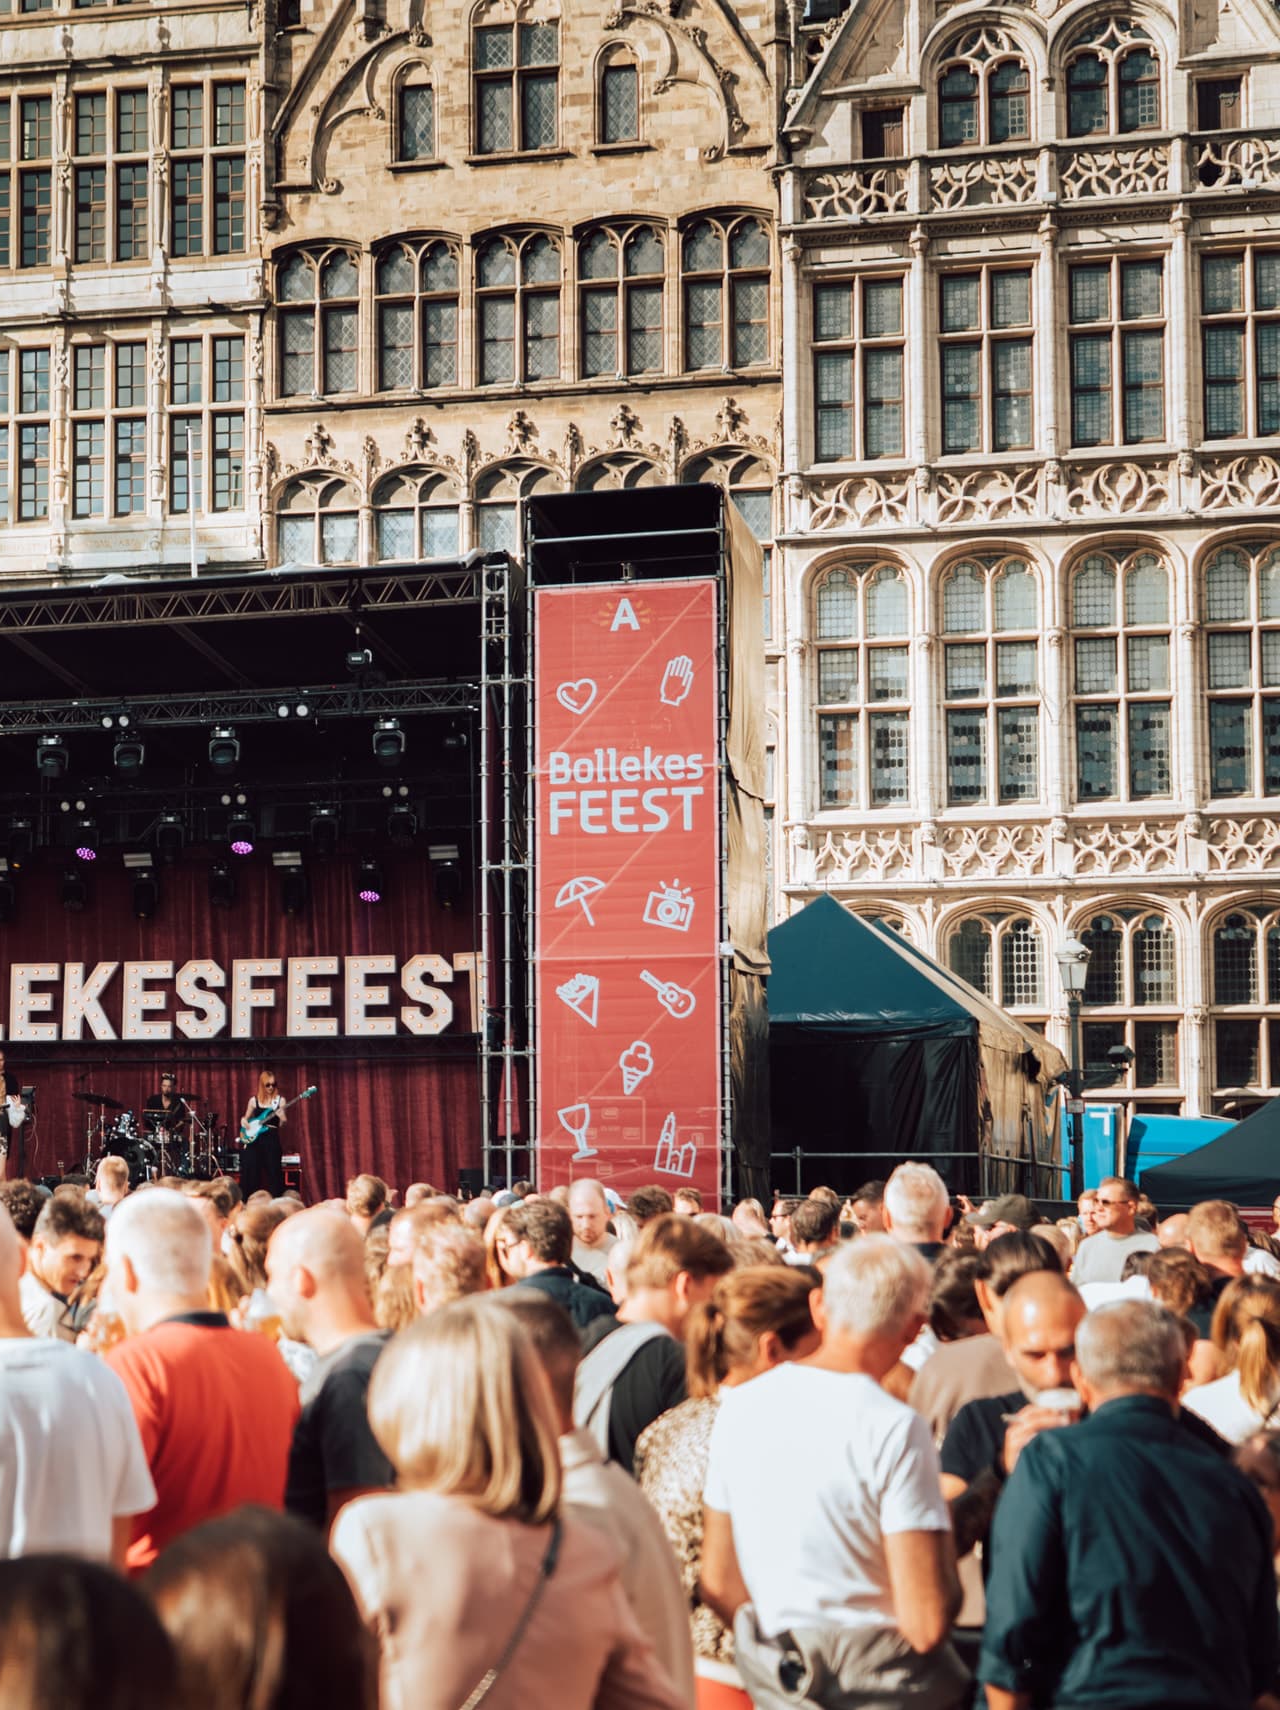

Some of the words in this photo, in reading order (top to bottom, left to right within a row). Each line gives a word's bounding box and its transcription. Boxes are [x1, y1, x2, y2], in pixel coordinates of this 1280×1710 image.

[610, 598, 641, 632] A
[549, 747, 704, 785] Bollekes
[549, 787, 705, 836] FEEST
